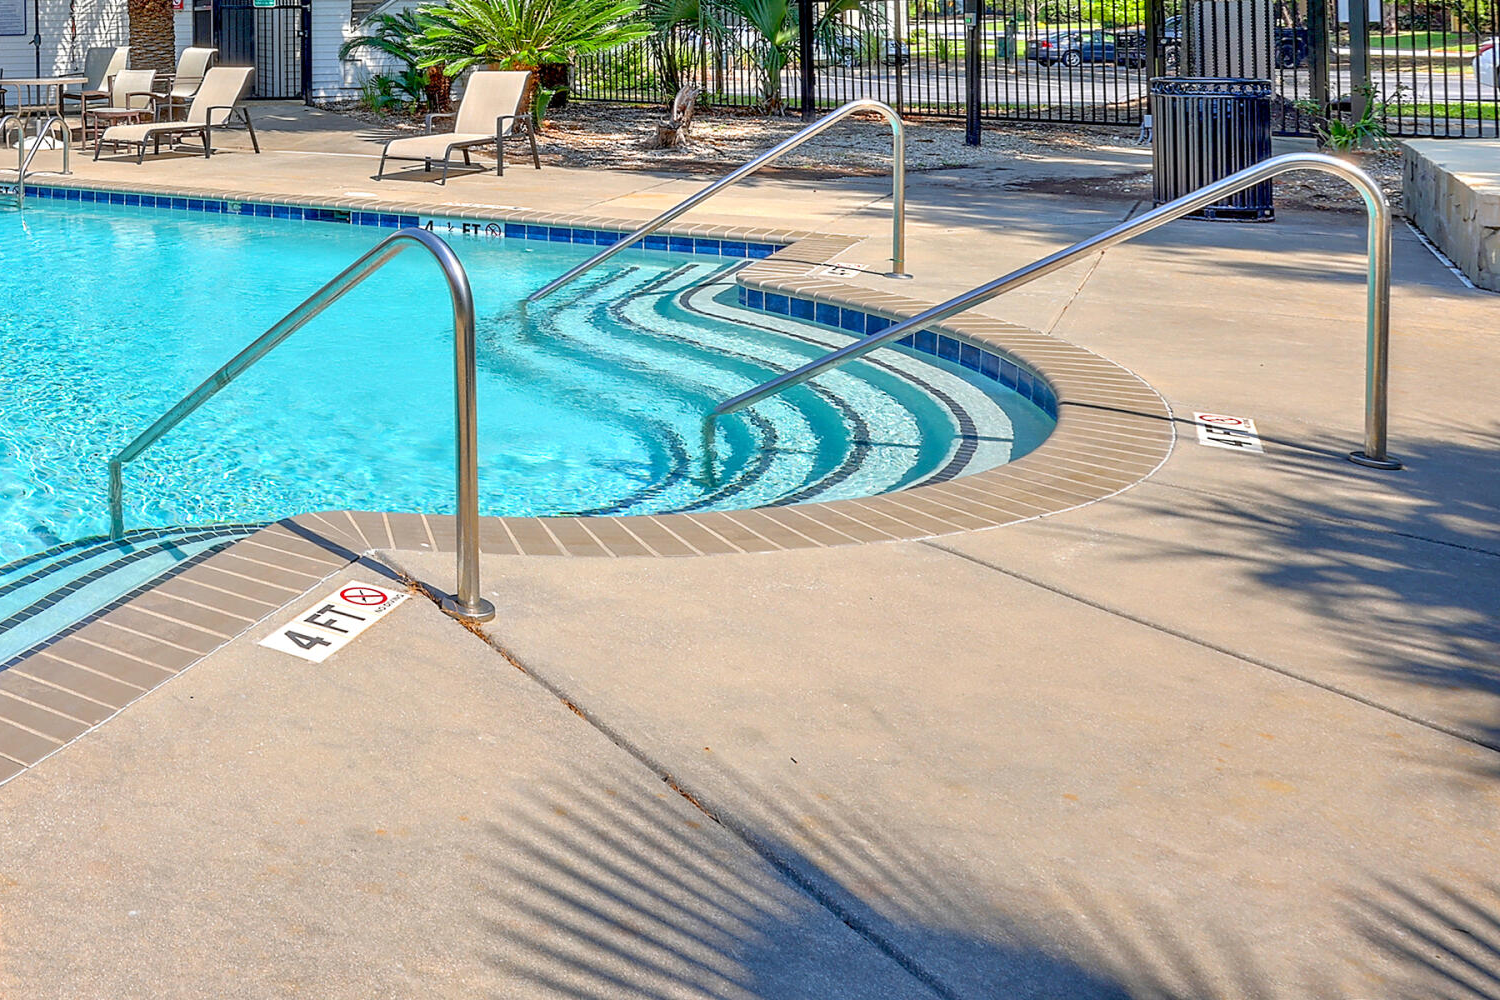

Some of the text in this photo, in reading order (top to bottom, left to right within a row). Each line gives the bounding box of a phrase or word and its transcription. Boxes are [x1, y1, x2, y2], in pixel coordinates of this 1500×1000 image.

[462, 223, 481, 235] FT
[284, 604, 366, 650] 4 FT
